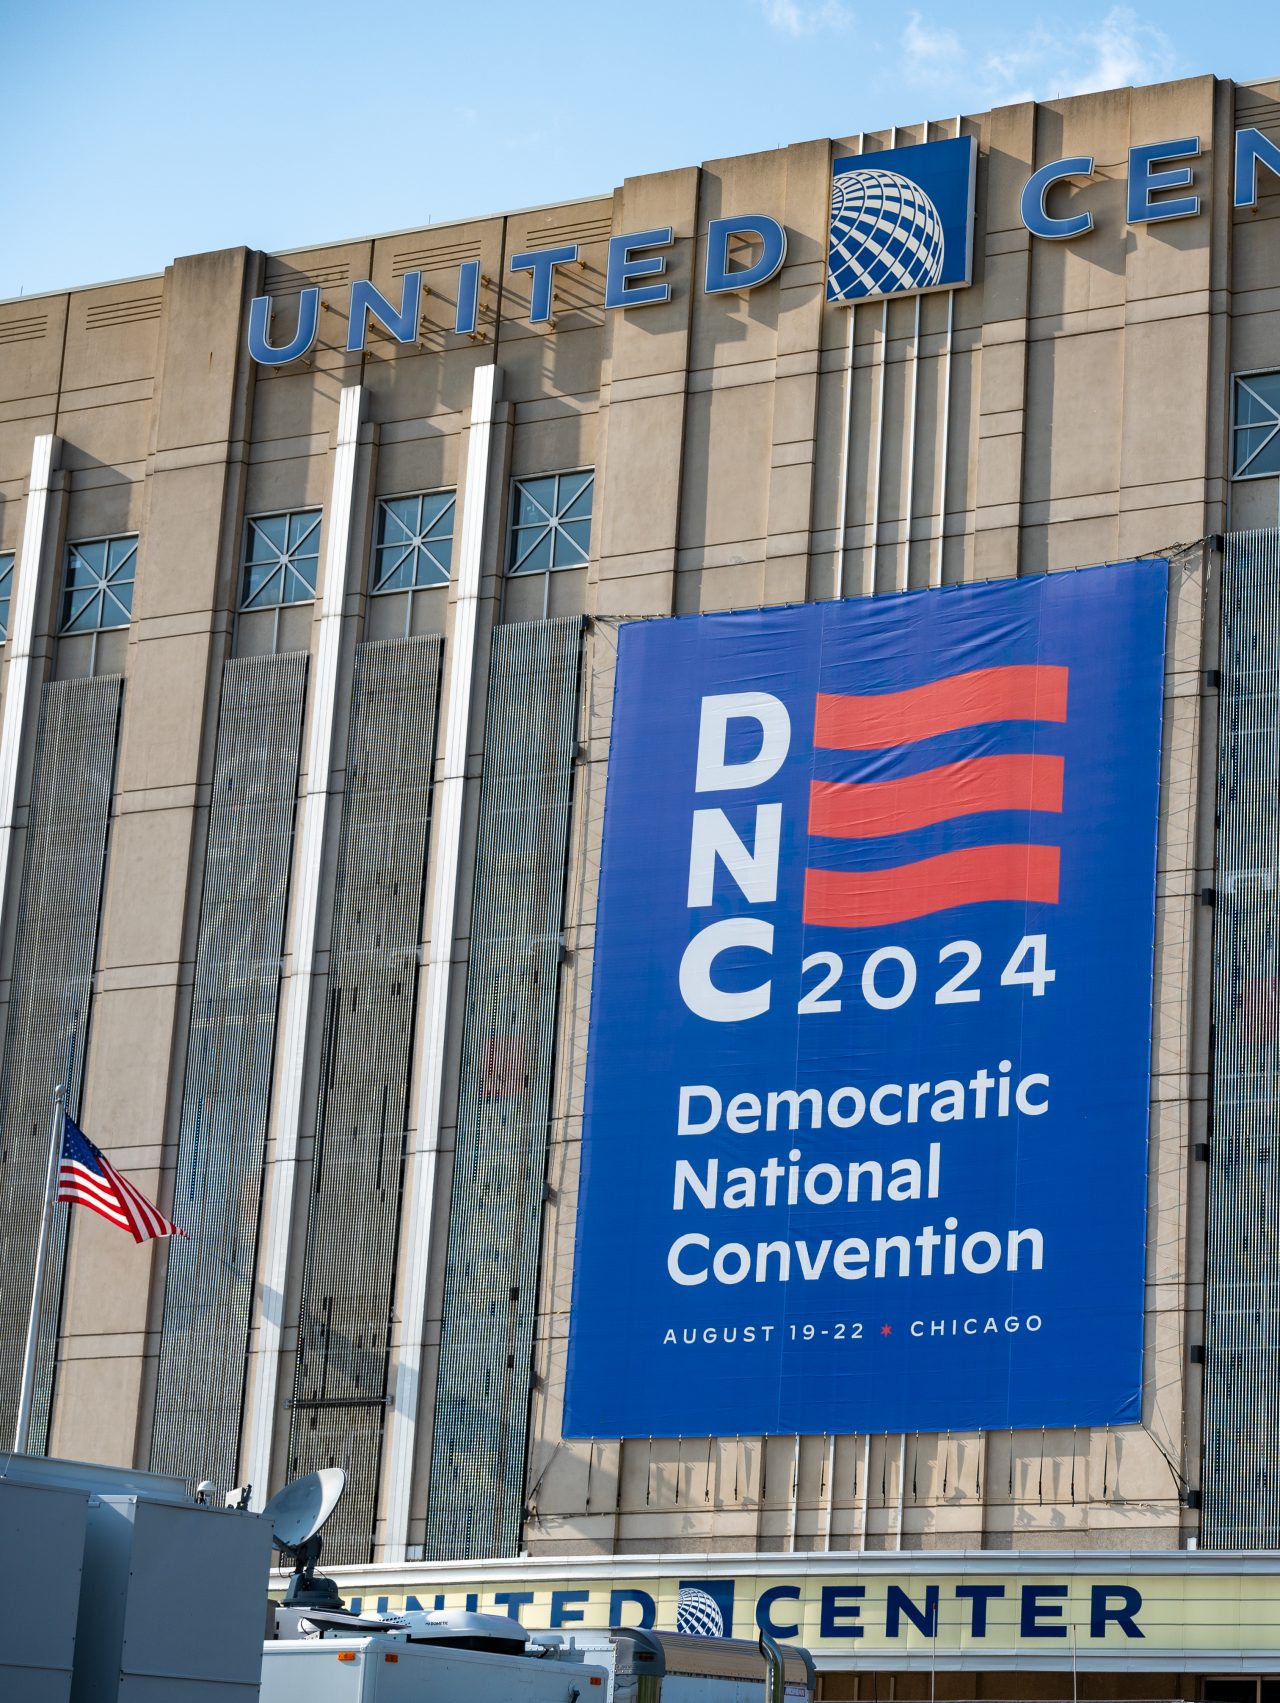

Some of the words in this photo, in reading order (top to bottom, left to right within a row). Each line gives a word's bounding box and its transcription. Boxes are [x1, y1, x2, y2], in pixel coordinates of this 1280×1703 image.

[247, 213, 788, 366] UNITED
[797, 933, 1057, 1015] 2024
[677, 1059, 1050, 1136] Democratic
[672, 1142, 941, 1210] National
[667, 1216, 1044, 1286] Convention
[663, 1325, 775, 1345] AUGUST
[789, 1322, 865, 1341] 19-22
[910, 1314, 1043, 1338] CHICAGO
[755, 1585, 1146, 1639] CENTER
